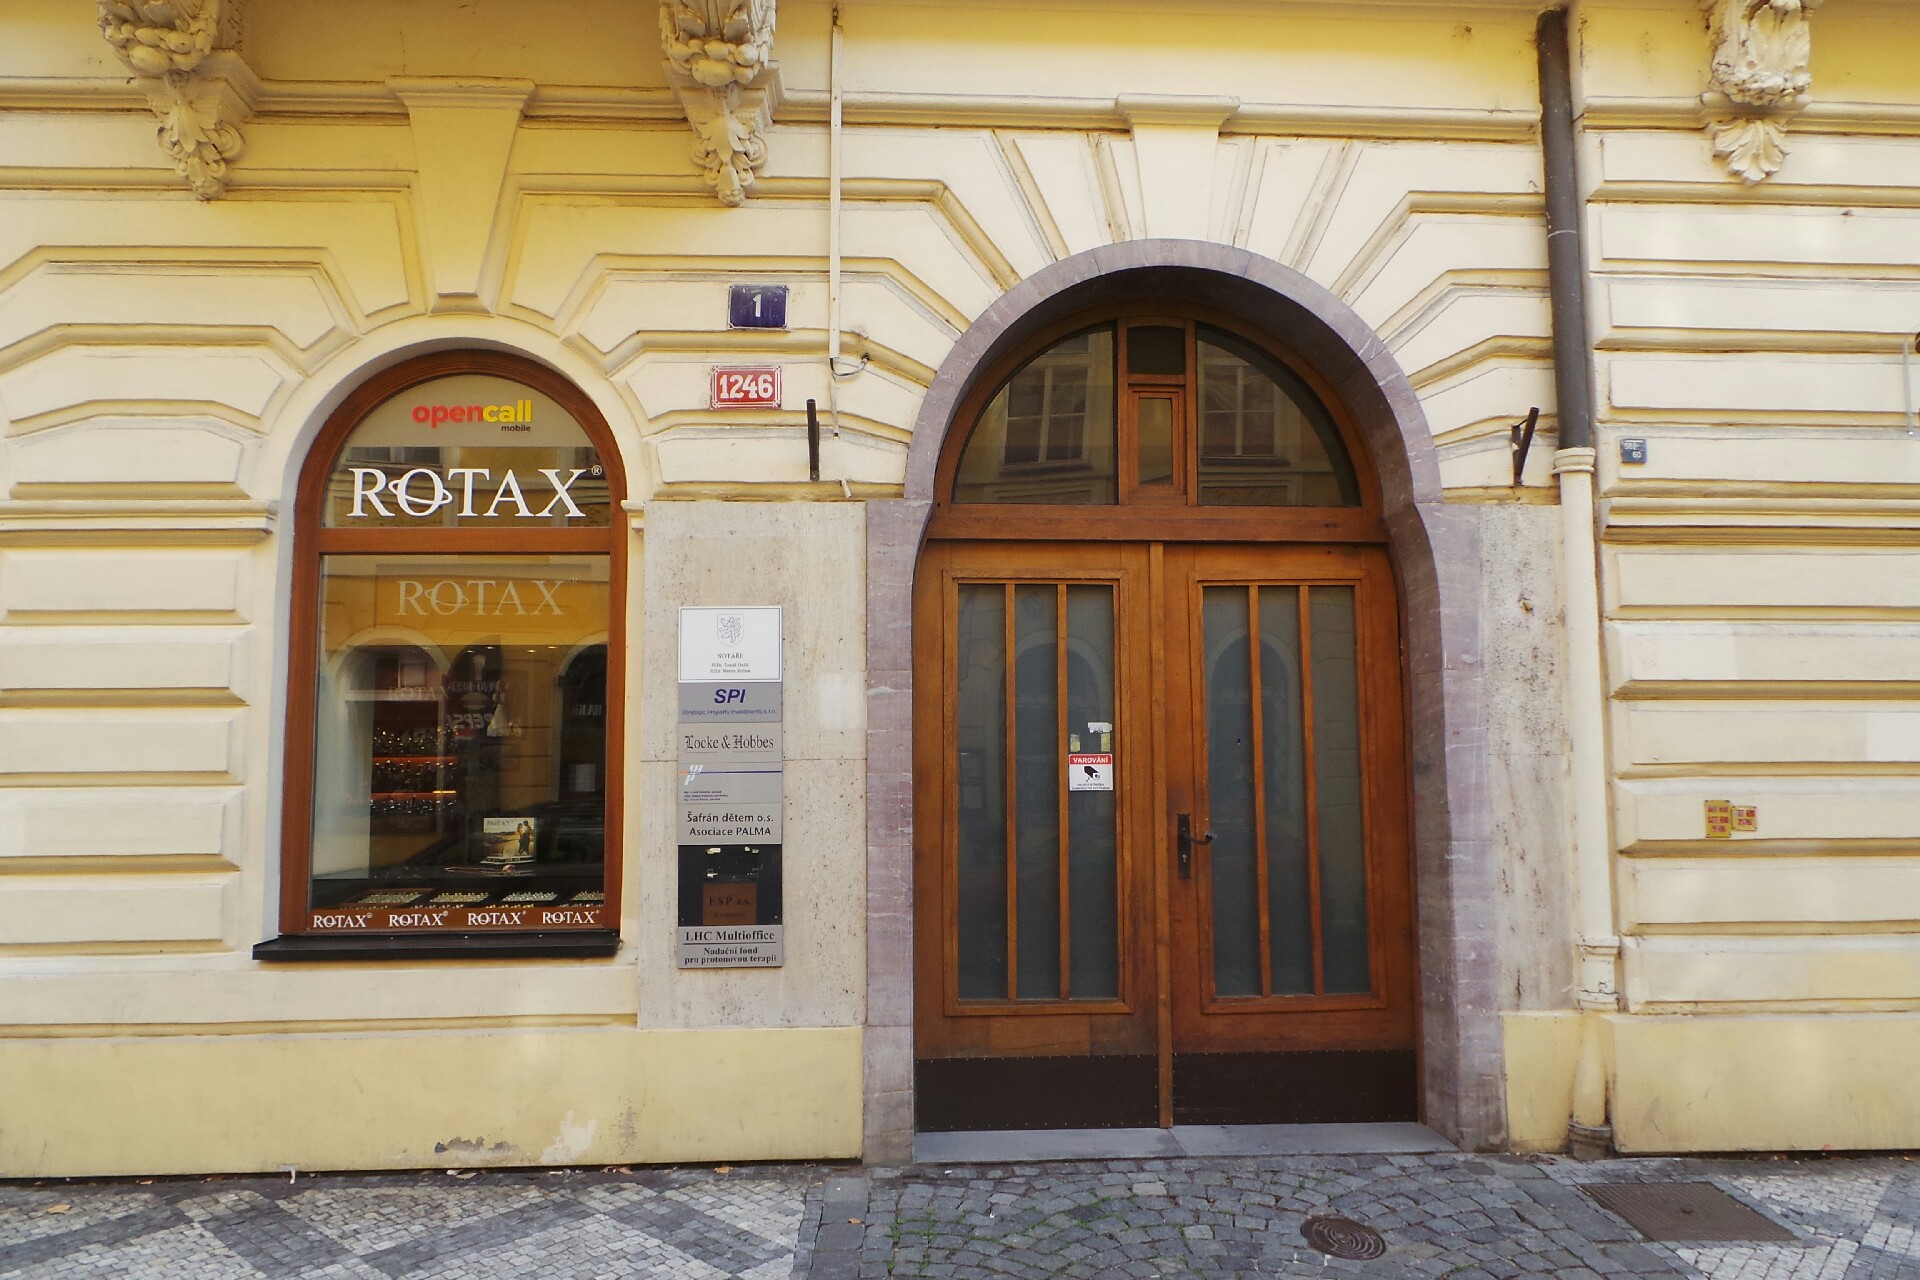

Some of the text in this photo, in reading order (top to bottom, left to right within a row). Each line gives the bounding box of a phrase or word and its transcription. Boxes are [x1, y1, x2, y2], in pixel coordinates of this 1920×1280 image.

[752, 293, 762, 318] 1
[719, 373, 773, 399] 1246
[411, 399, 532, 429] opencall
[501, 424, 531, 432] mobile
[713, 688, 746, 704] SPI
[684, 734, 774, 750] Locke & Hobbes
[1072, 756, 1109, 764] VAROVÁNÍ
[687, 810, 719, 823] Šafrán
[721, 812, 754, 823] dětem
[689, 827, 771, 836] Asociace PALMA
[685, 930, 775, 941] LHC Multioffice
[703, 946, 758, 955] Nadační fond
[684, 954, 777, 965] pro protonovou terapii
